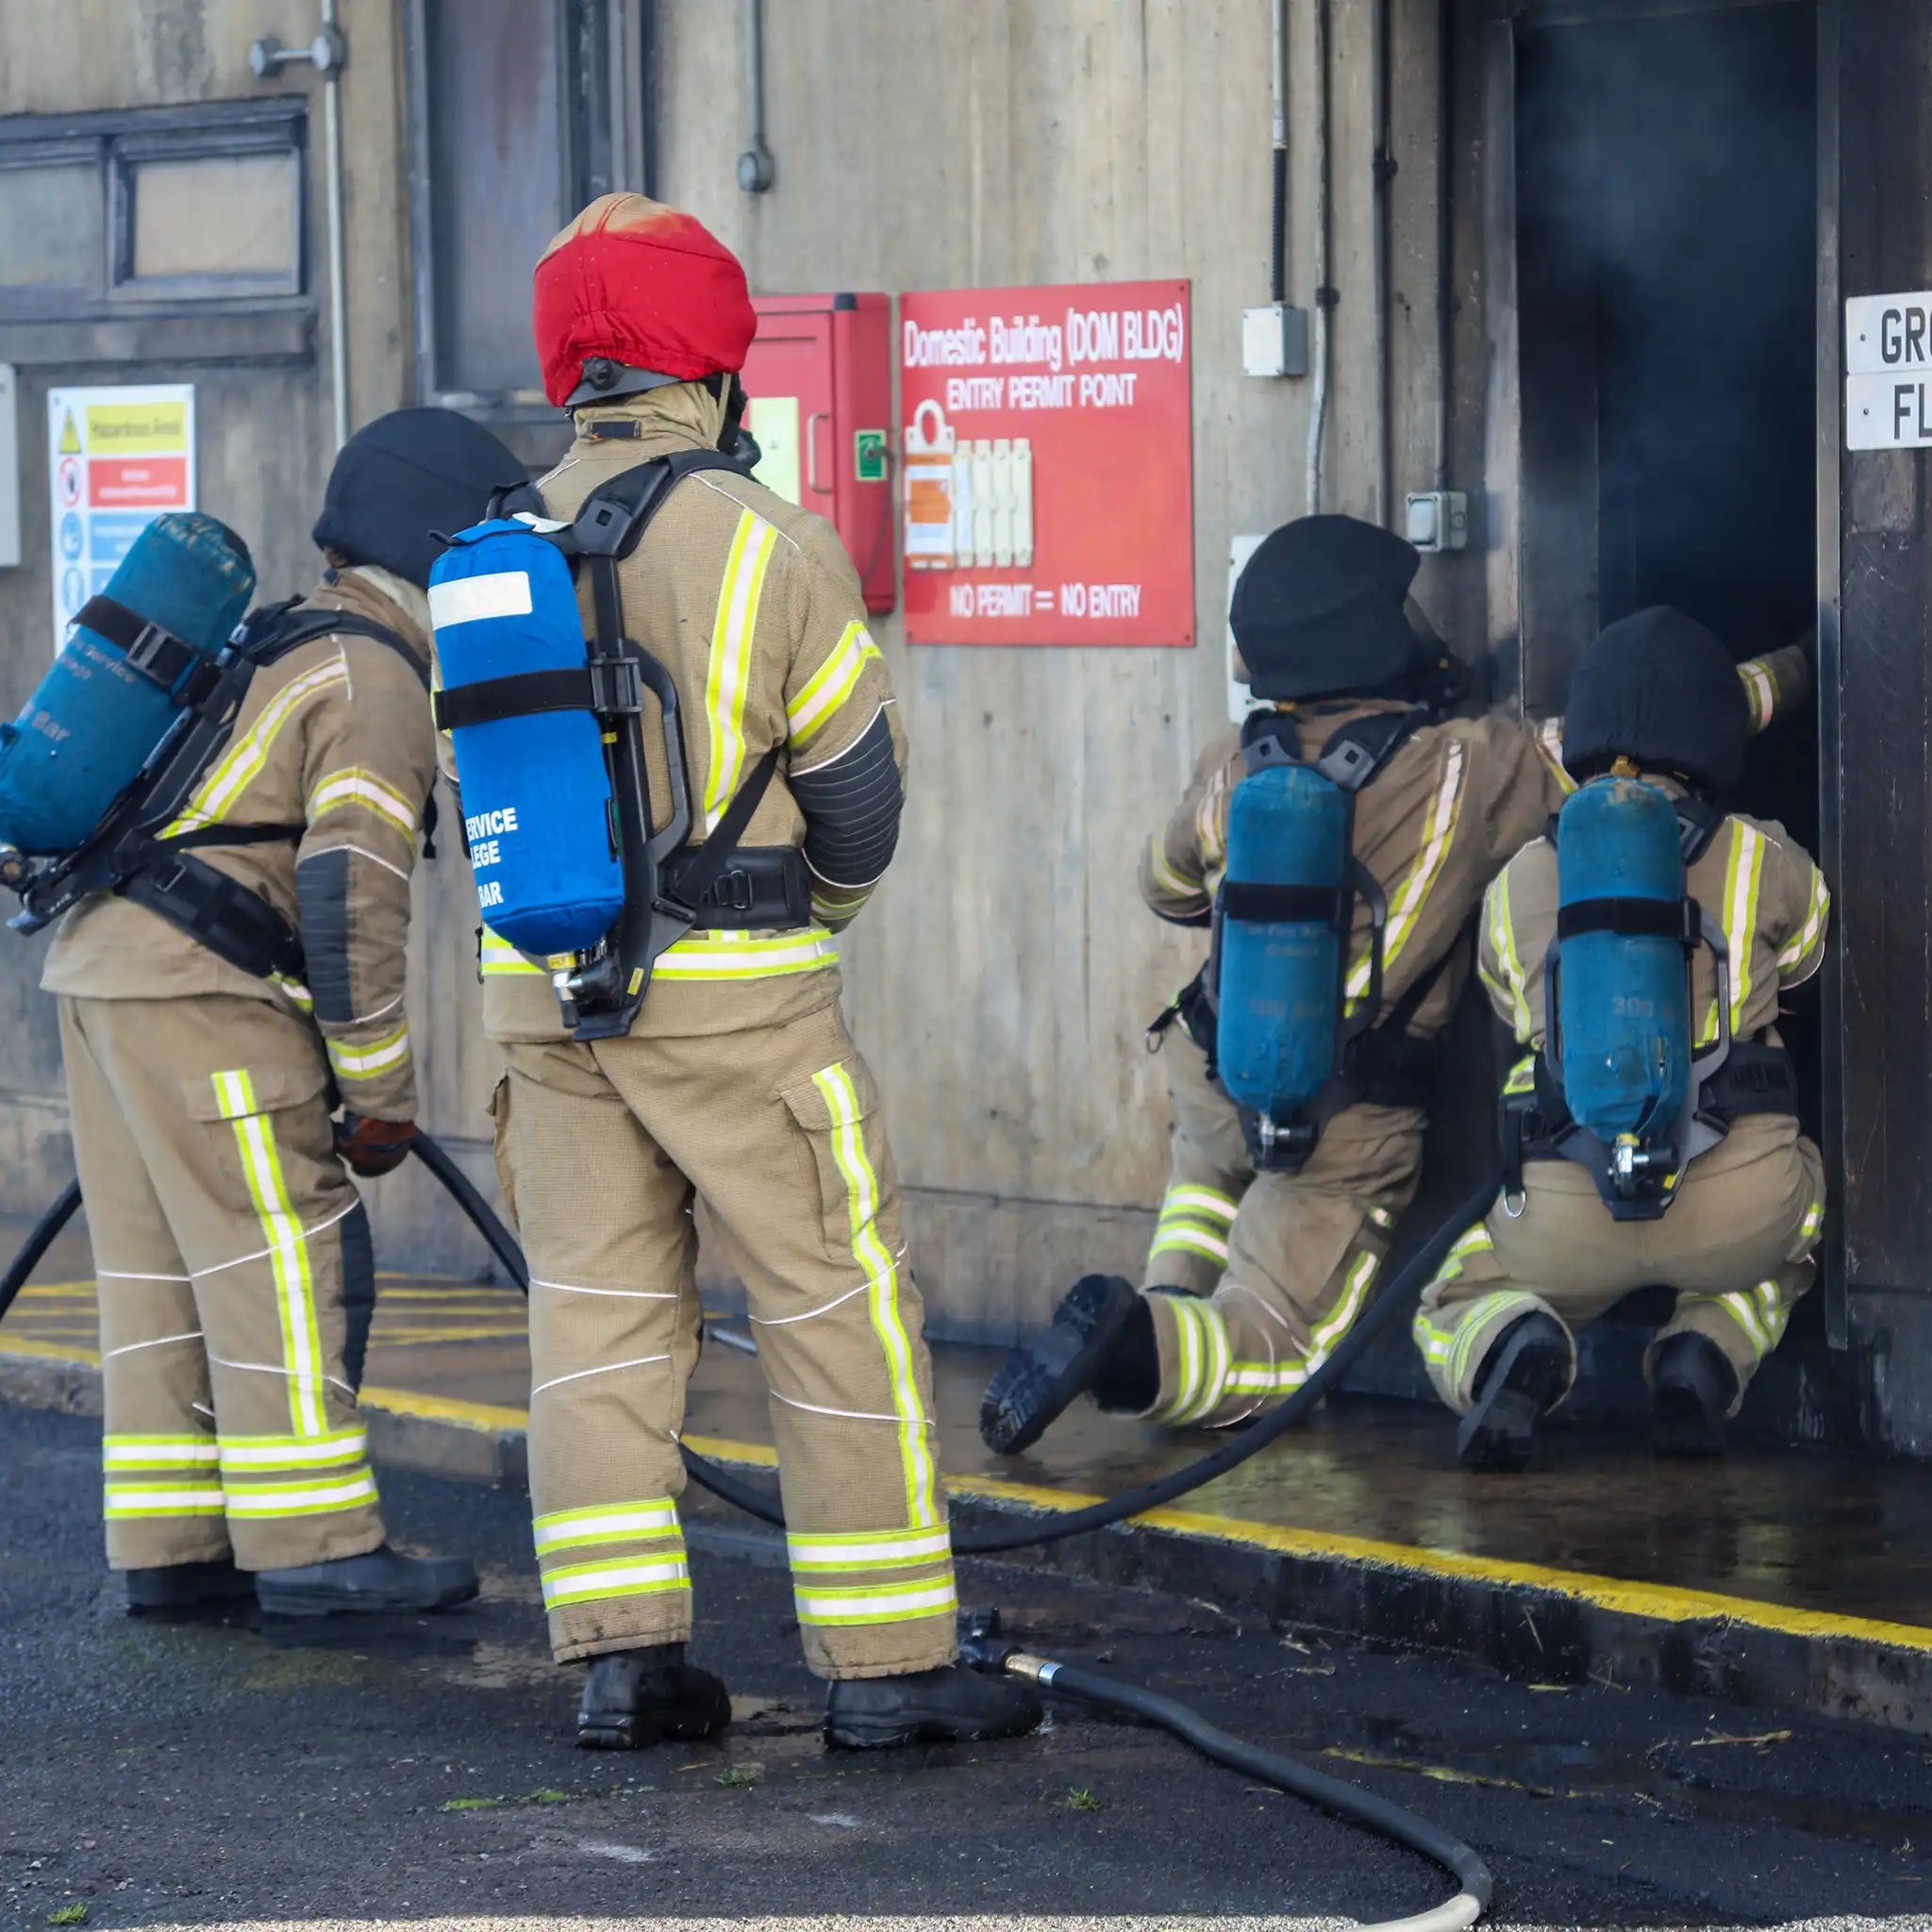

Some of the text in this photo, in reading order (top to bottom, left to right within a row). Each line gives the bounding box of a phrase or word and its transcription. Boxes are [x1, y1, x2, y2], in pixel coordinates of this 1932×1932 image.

[904, 302, 1183, 372] Domestic Building (DOM BLDG)
[1881, 307, 1932, 364] GR
[947, 373, 1138, 410] ENTRY PERMIT POINT
[949, 583, 974, 618] NO
[976, 583, 1033, 617] PERMIT
[1061, 582, 1087, 618] NO
[1089, 583, 1141, 618] ENTRY
